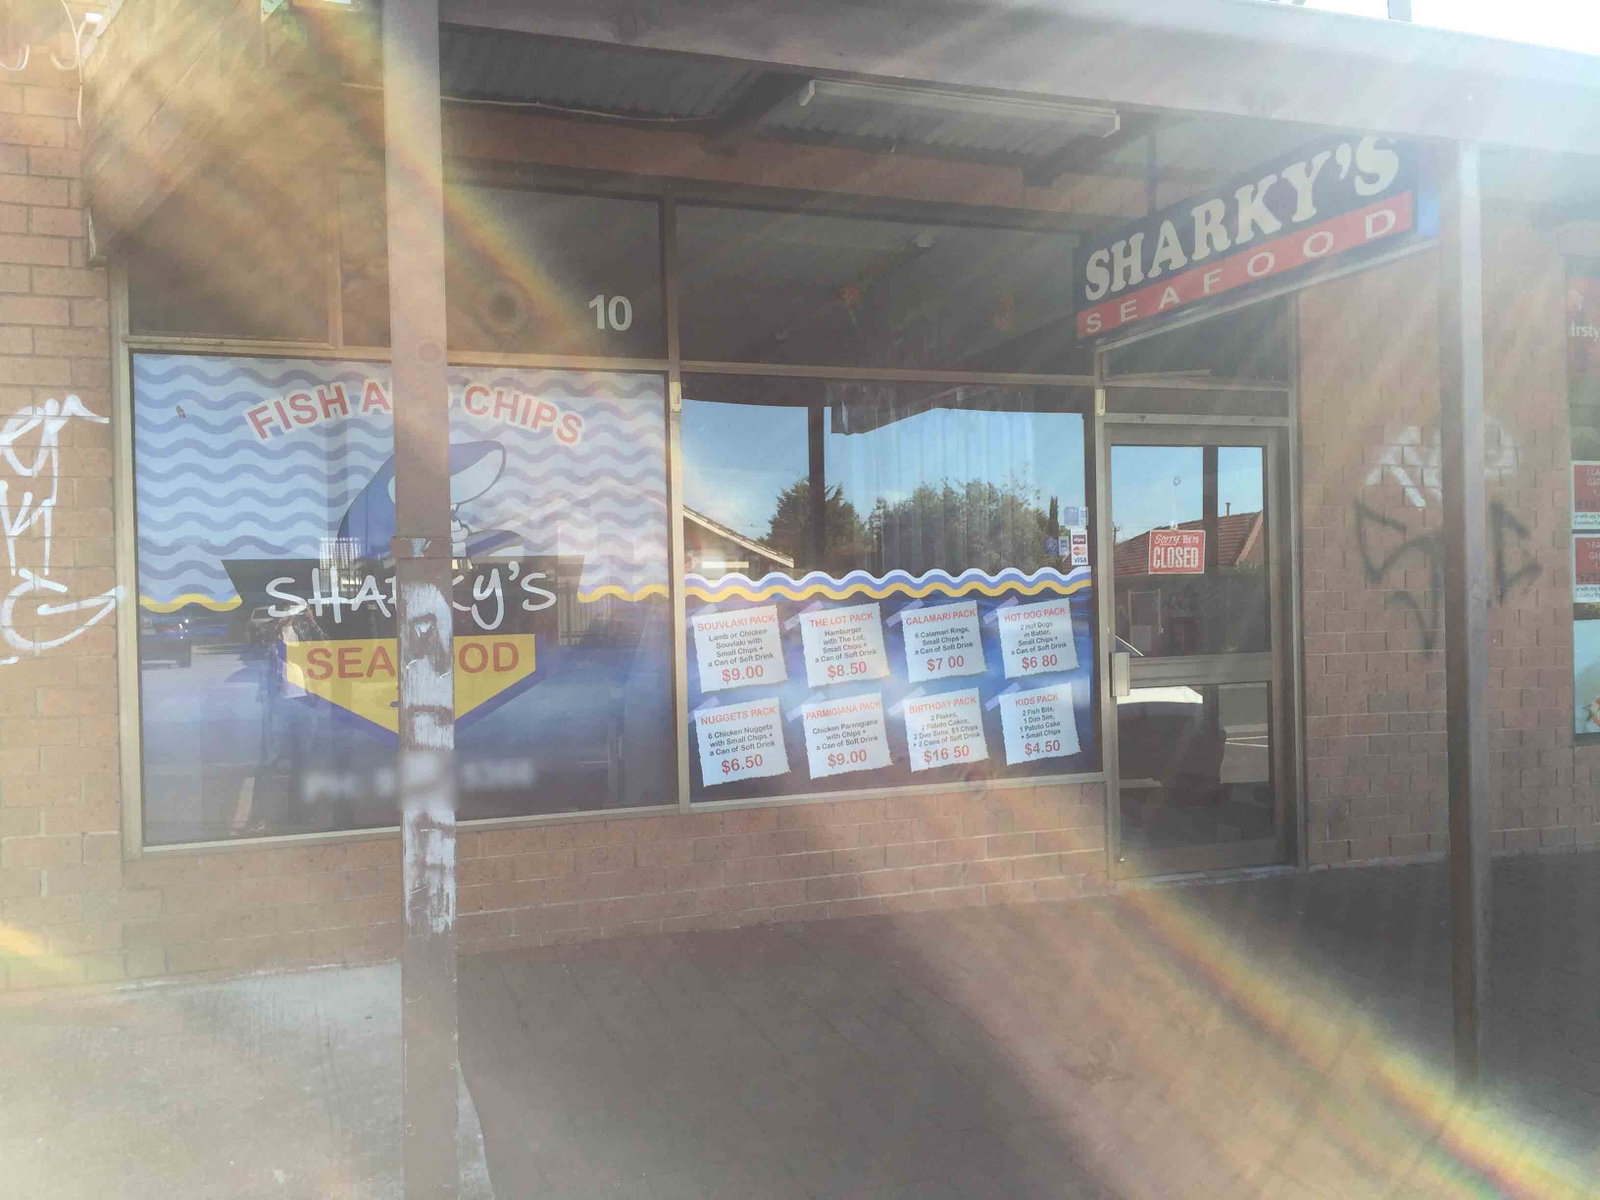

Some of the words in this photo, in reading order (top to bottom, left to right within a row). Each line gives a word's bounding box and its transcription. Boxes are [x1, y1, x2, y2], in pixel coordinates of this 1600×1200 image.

[1084, 136, 1400, 300] SHARKY'S
[1086, 209, 1397, 334] SEAFOOD
[589, 295, 632, 330] 10
[247, 382, 349, 439] FISH
[464, 386, 583, 444] CHIPS
[1154, 535, 1180, 545] Sorry
[1154, 547, 1198, 568] CLOSED
[265, 560, 557, 630] SHAY'S
[810, 618, 827, 627] THE
[831, 616, 847, 625] LOT
[850, 612, 873, 621] PACK
[906, 613, 951, 625] CALAMARI
[952, 609, 976, 618] PACK
[1005, 613, 1022, 622] HOT
[1024, 610, 1042, 619] DOG
[1044, 607, 1066, 616] PACK
[698, 619, 747, 631] SOUVLAKI
[751, 615, 775, 624] PACK
[709, 633, 728, 641] Lamb
[740, 629, 767, 637] Chicken
[825, 627, 862, 636] Hamburger
[921, 630, 948, 638] Calamari
[717, 649, 735, 657] Small
[738, 647, 757, 655] Chips
[755, 652, 774, 660] Drink
[307, 642, 520, 680] SEAOD
[927, 655, 964, 673] $700
[1022, 654, 1057, 671] $680
[722, 665, 763, 685] $9.00
[827, 661, 867, 680] $8.50
[909, 701, 950, 714] BIRTHDAY
[954, 697, 977, 706] PACK
[1015, 698, 1034, 706] KIDS
[1037, 693, 1059, 704] PACK
[701, 711, 748, 725] NUGGETS
[751, 706, 776, 717] PACK
[806, 704, 858, 720] PARMIGIANA
[714, 729, 742, 738] Chicken
[744, 724, 773, 733] Nuggets
[812, 726, 839, 734] Chicken
[841, 720, 878, 729] Parmigiana
[926, 721, 946, 729] Potato
[1025, 724, 1044, 732] Potato
[727, 737, 745, 745] Small
[748, 734, 767, 742] Chips
[825, 733, 840, 741] with
[842, 730, 861, 738] Chips
[757, 740, 775, 748] Drink
[1025, 740, 1060, 757] $4.50
[828, 748, 867, 769] $9.00
[924, 745, 969, 765] $1650
[721, 754, 763, 775] $6.50
